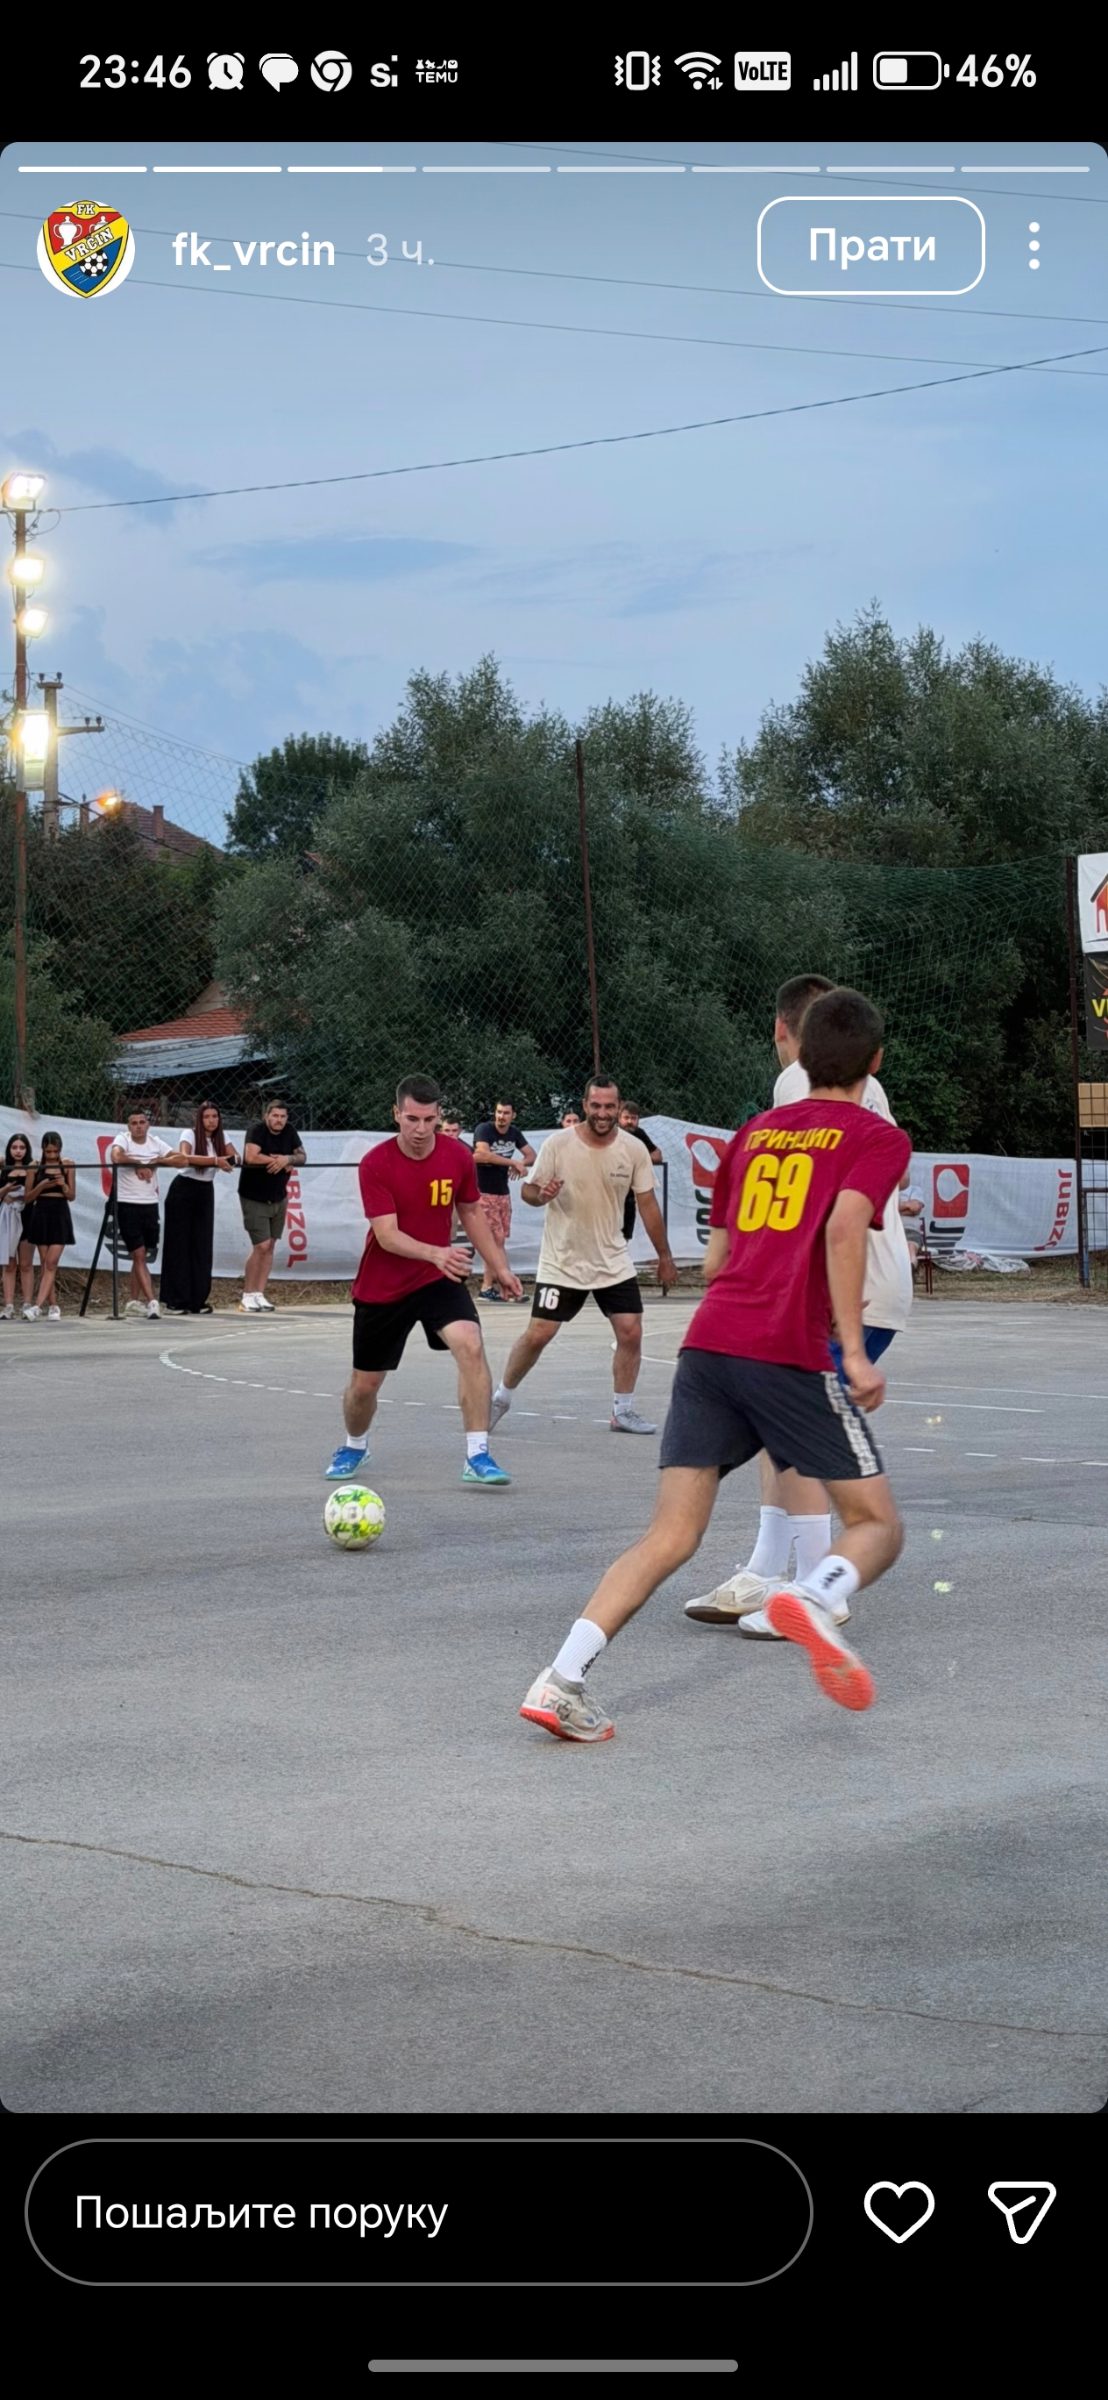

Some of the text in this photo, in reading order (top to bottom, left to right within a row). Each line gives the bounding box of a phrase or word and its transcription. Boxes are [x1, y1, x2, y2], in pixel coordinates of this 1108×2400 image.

[743, 1127, 844, 1152] ПРИНЦИП
[430, 1179, 453, 1206] 15
[737, 1152, 814, 1232] 69
[539, 1287, 561, 1310] 16
